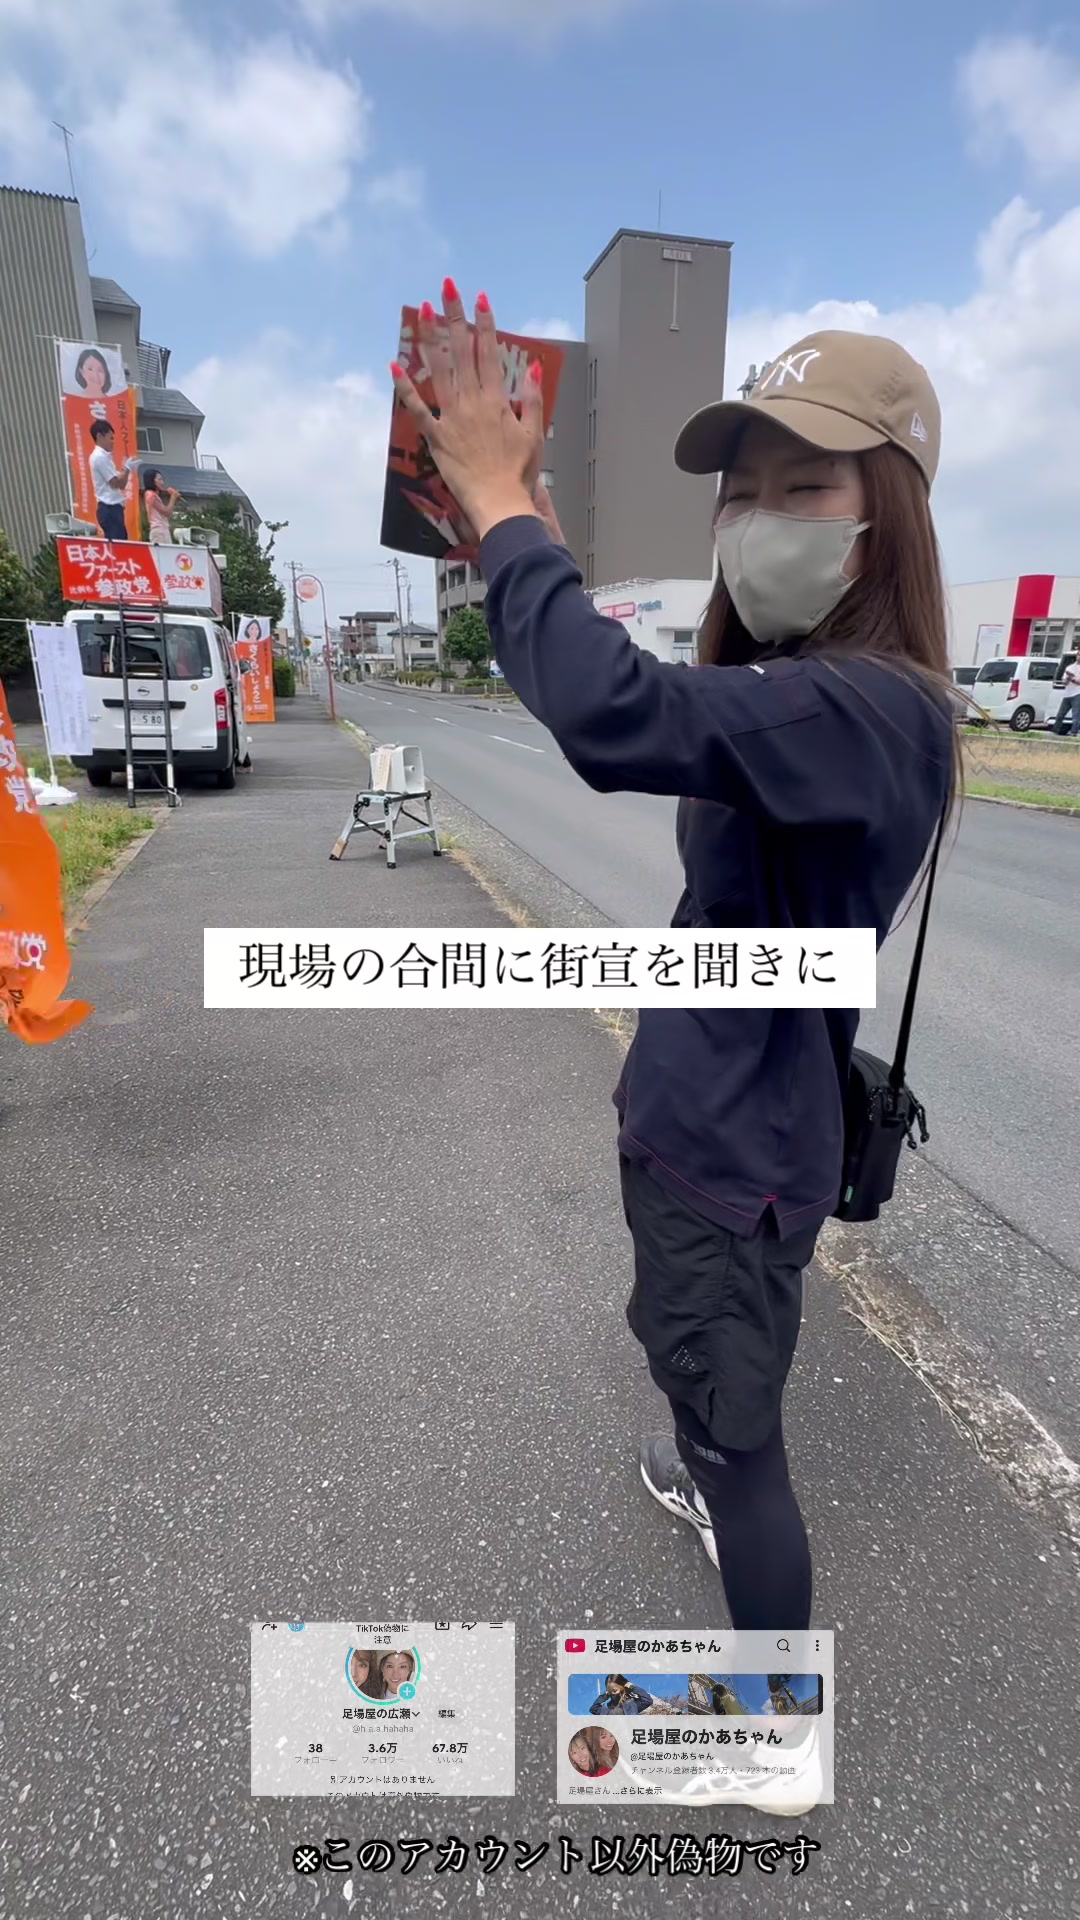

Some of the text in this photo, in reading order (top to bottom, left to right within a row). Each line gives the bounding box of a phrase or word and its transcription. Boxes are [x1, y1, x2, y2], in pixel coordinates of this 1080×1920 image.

[66, 544, 116, 562] 日本人
[80, 558, 141, 579] ファースト
[95, 576, 152, 598] 参政党
[164, 573, 206, 591] 参政党
